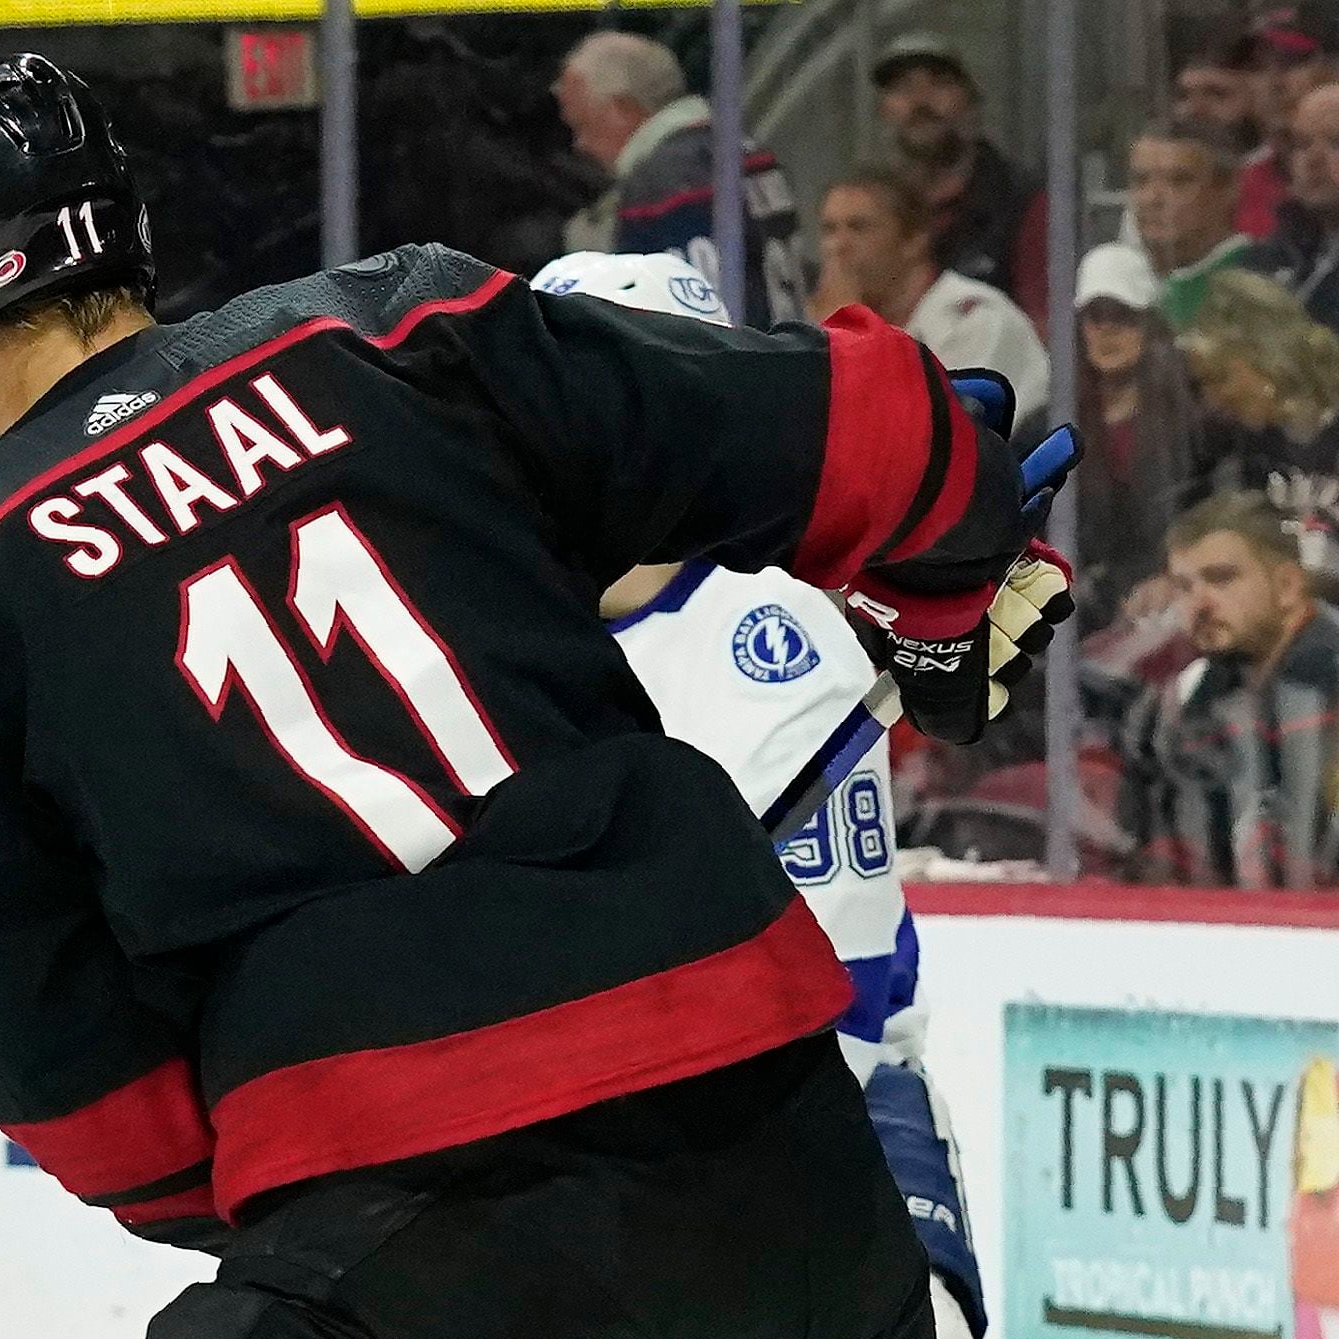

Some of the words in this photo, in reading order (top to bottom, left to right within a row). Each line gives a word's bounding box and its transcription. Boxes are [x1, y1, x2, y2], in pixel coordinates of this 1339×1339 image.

[57, 201, 104, 260] 11
[85, 390, 159, 436] adidas
[27, 370, 353, 580] STAAL
[174, 500, 519, 876] 11
[886, 633, 974, 655] NEXUS
[1042, 1065, 1285, 1232] TRULY
